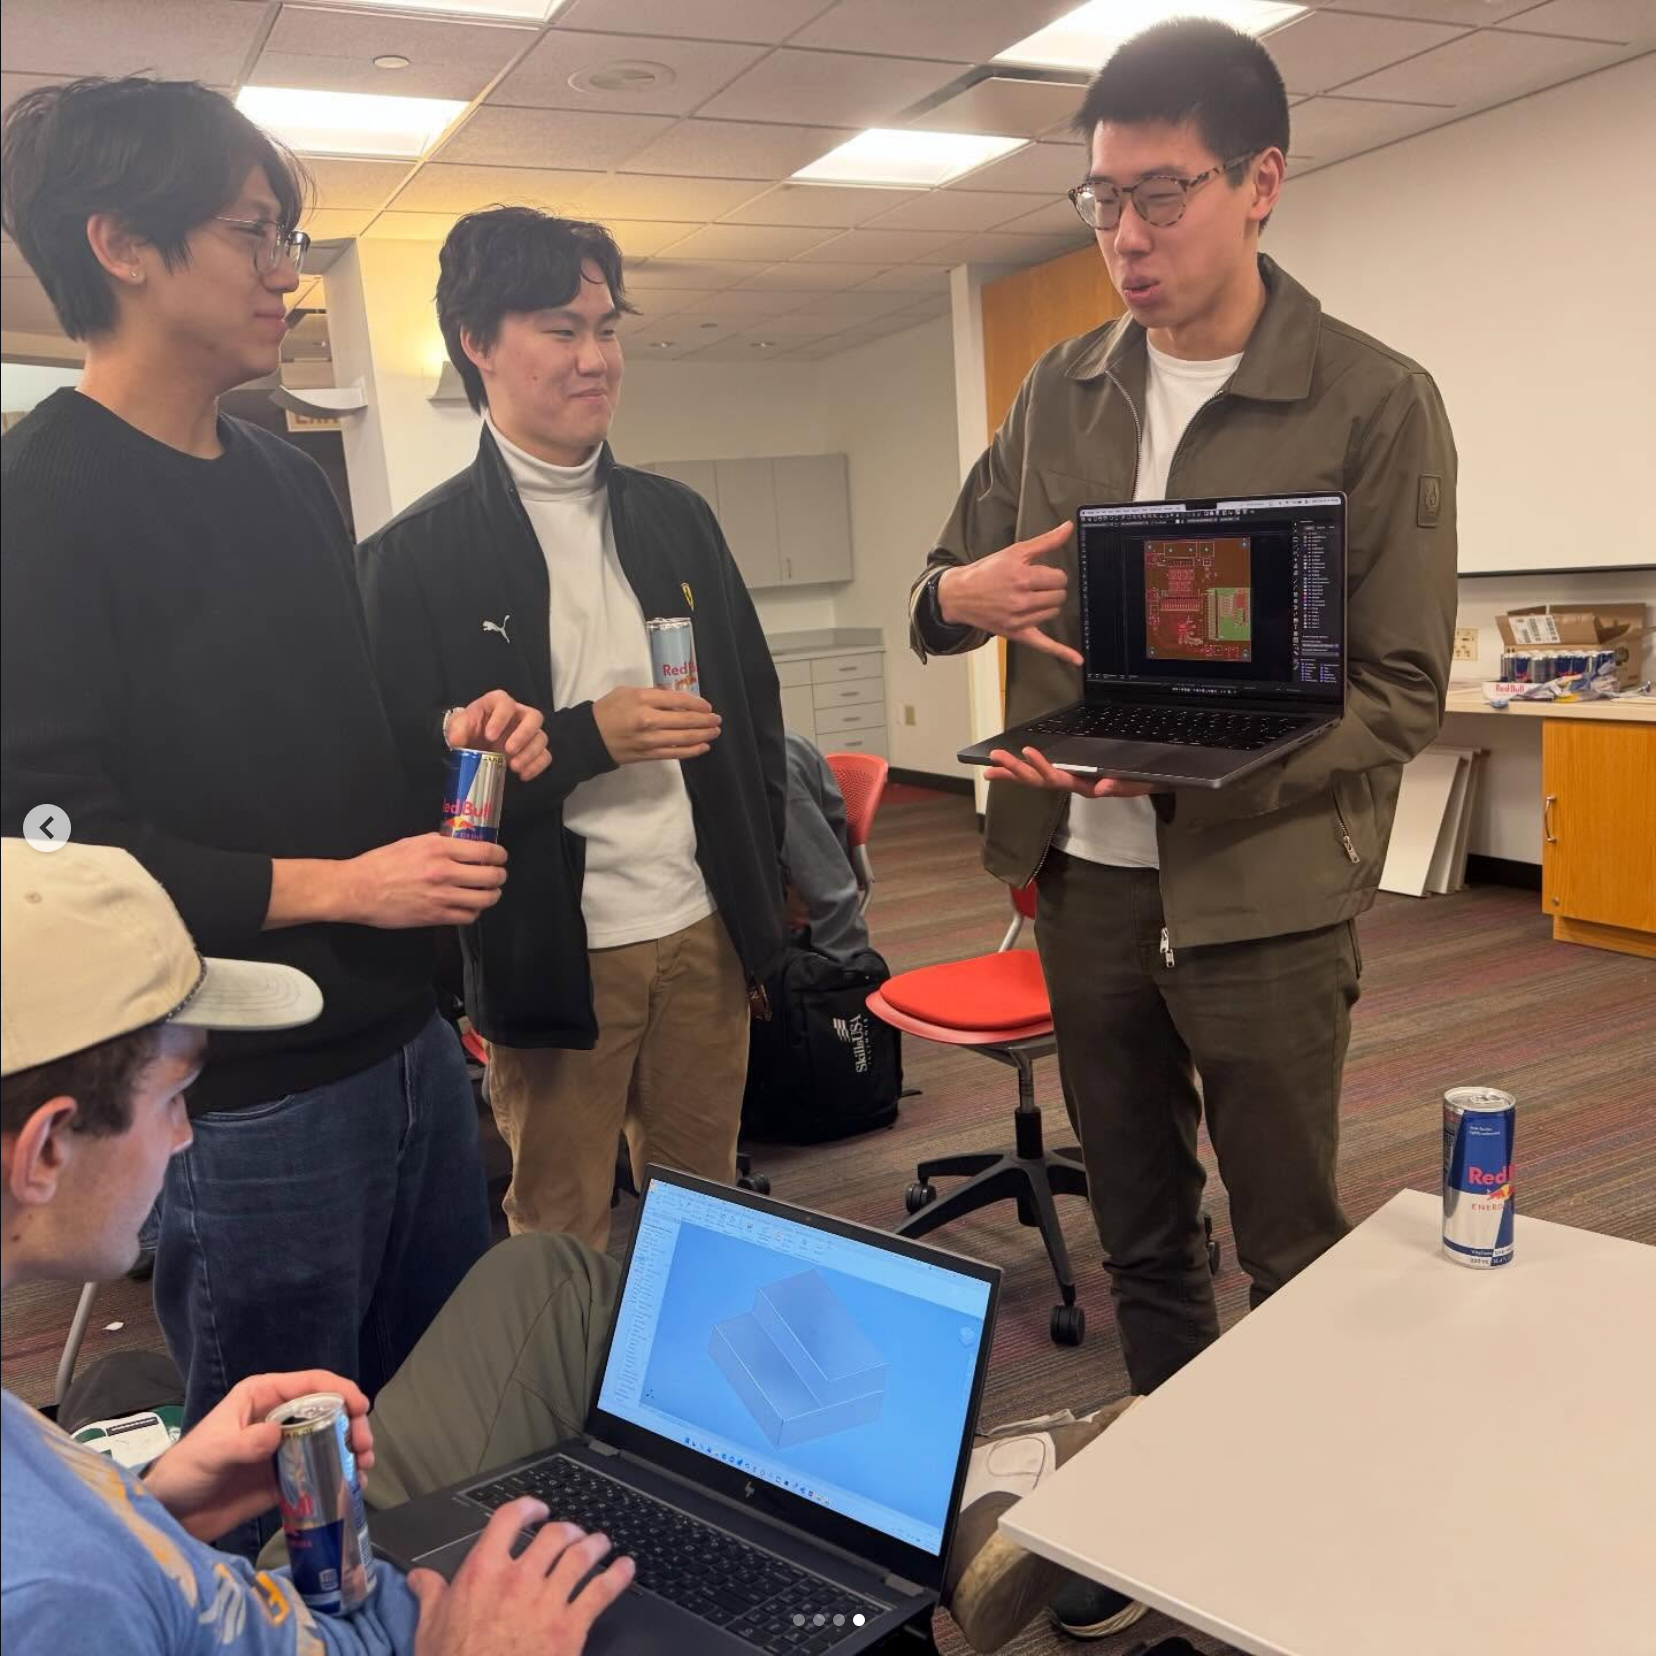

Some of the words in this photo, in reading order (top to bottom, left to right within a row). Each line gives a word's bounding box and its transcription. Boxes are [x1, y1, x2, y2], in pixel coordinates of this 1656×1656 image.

[662, 662, 687, 677] Red
[442, 799, 461, 815] ed
[849, 1013, 868, 1073] SkillsUSA
[1467, 1165, 1507, 1186] Red
